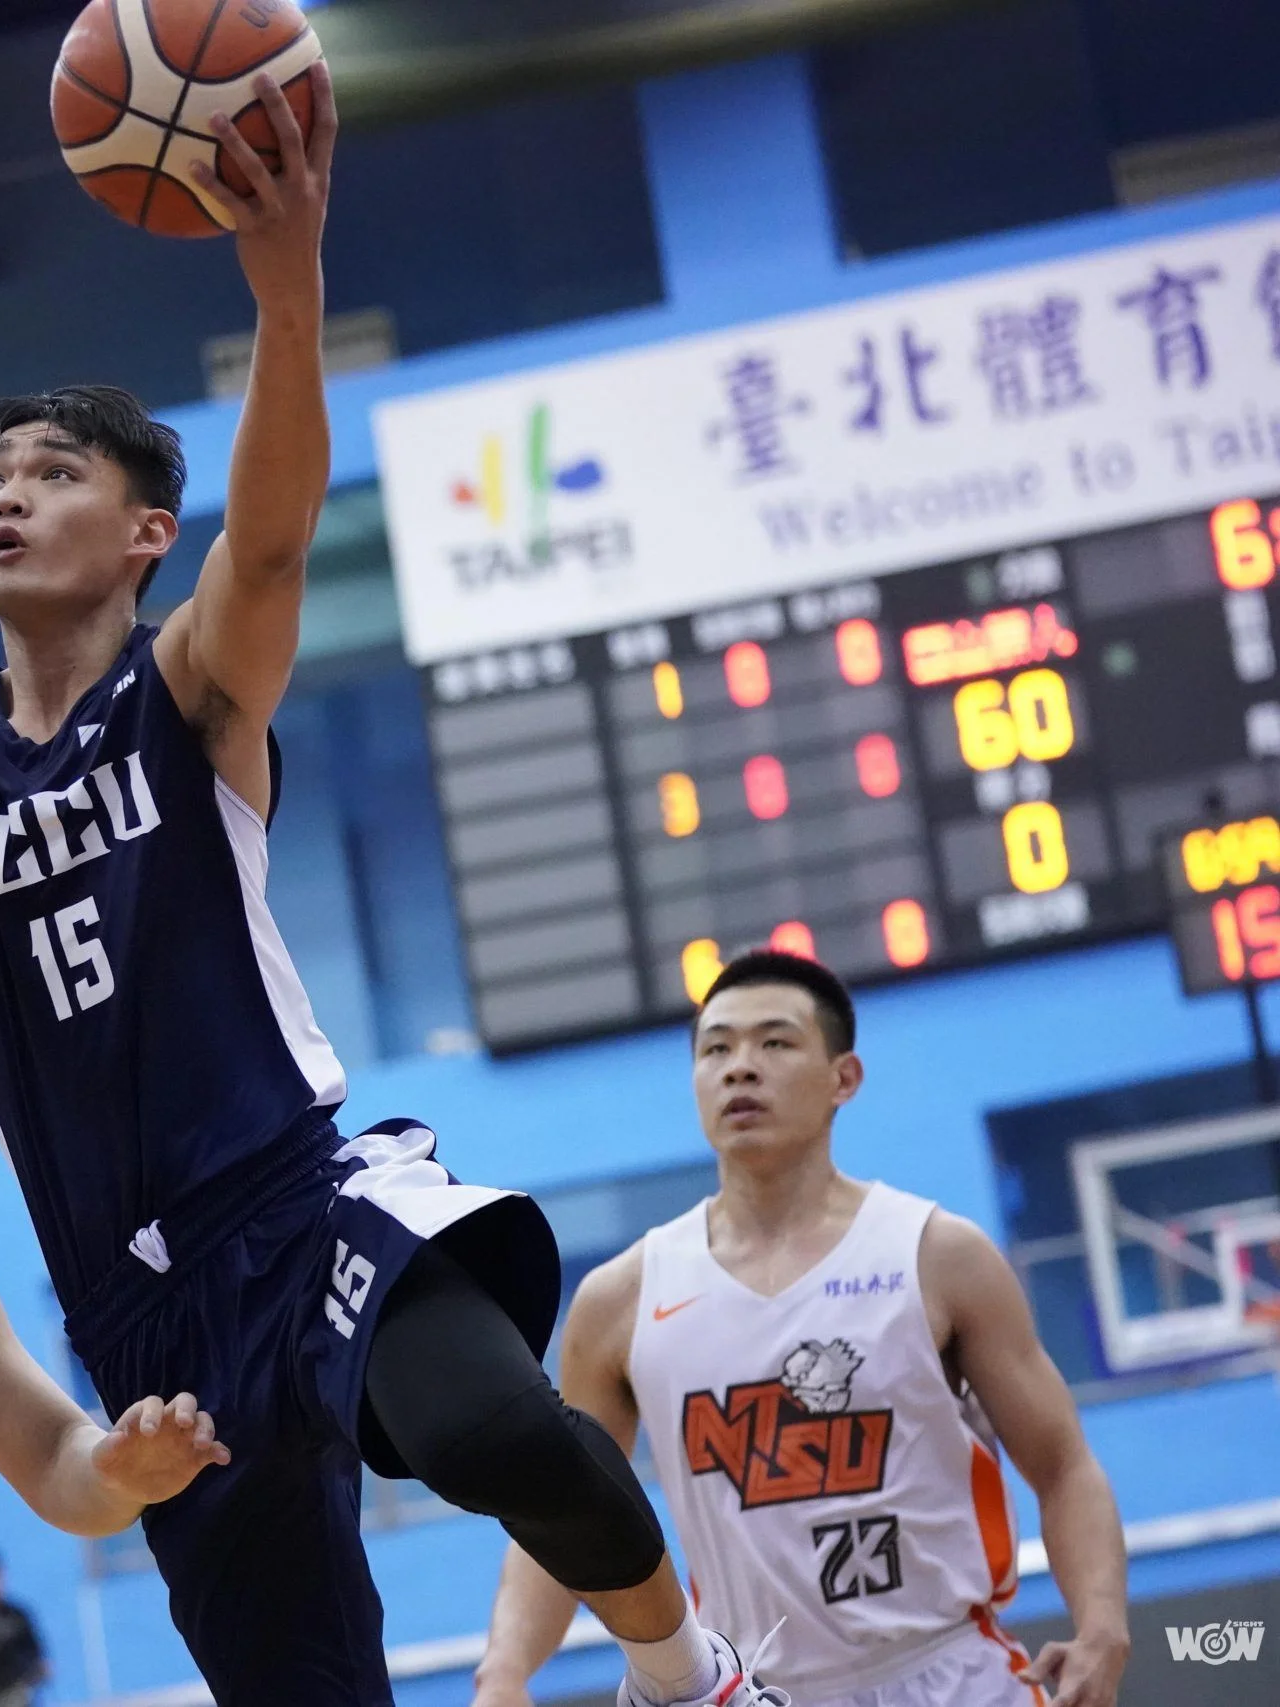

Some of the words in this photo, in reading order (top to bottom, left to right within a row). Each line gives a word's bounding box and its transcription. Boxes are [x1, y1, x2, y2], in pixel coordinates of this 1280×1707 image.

[705, 252, 1280, 485] 臺北體育
[756, 462, 1044, 550] Welcome
[1069, 438, 1136, 494] to
[1156, 401, 1280, 475] Tai
[443, 517, 635, 594] TAIPEI
[952, 667, 1076, 772] 60
[1001, 800, 1070, 894] 0
[29, 895, 115, 1022] 15
[324, 1238, 377, 1340] 15
[811, 1514, 905, 1606] 23
